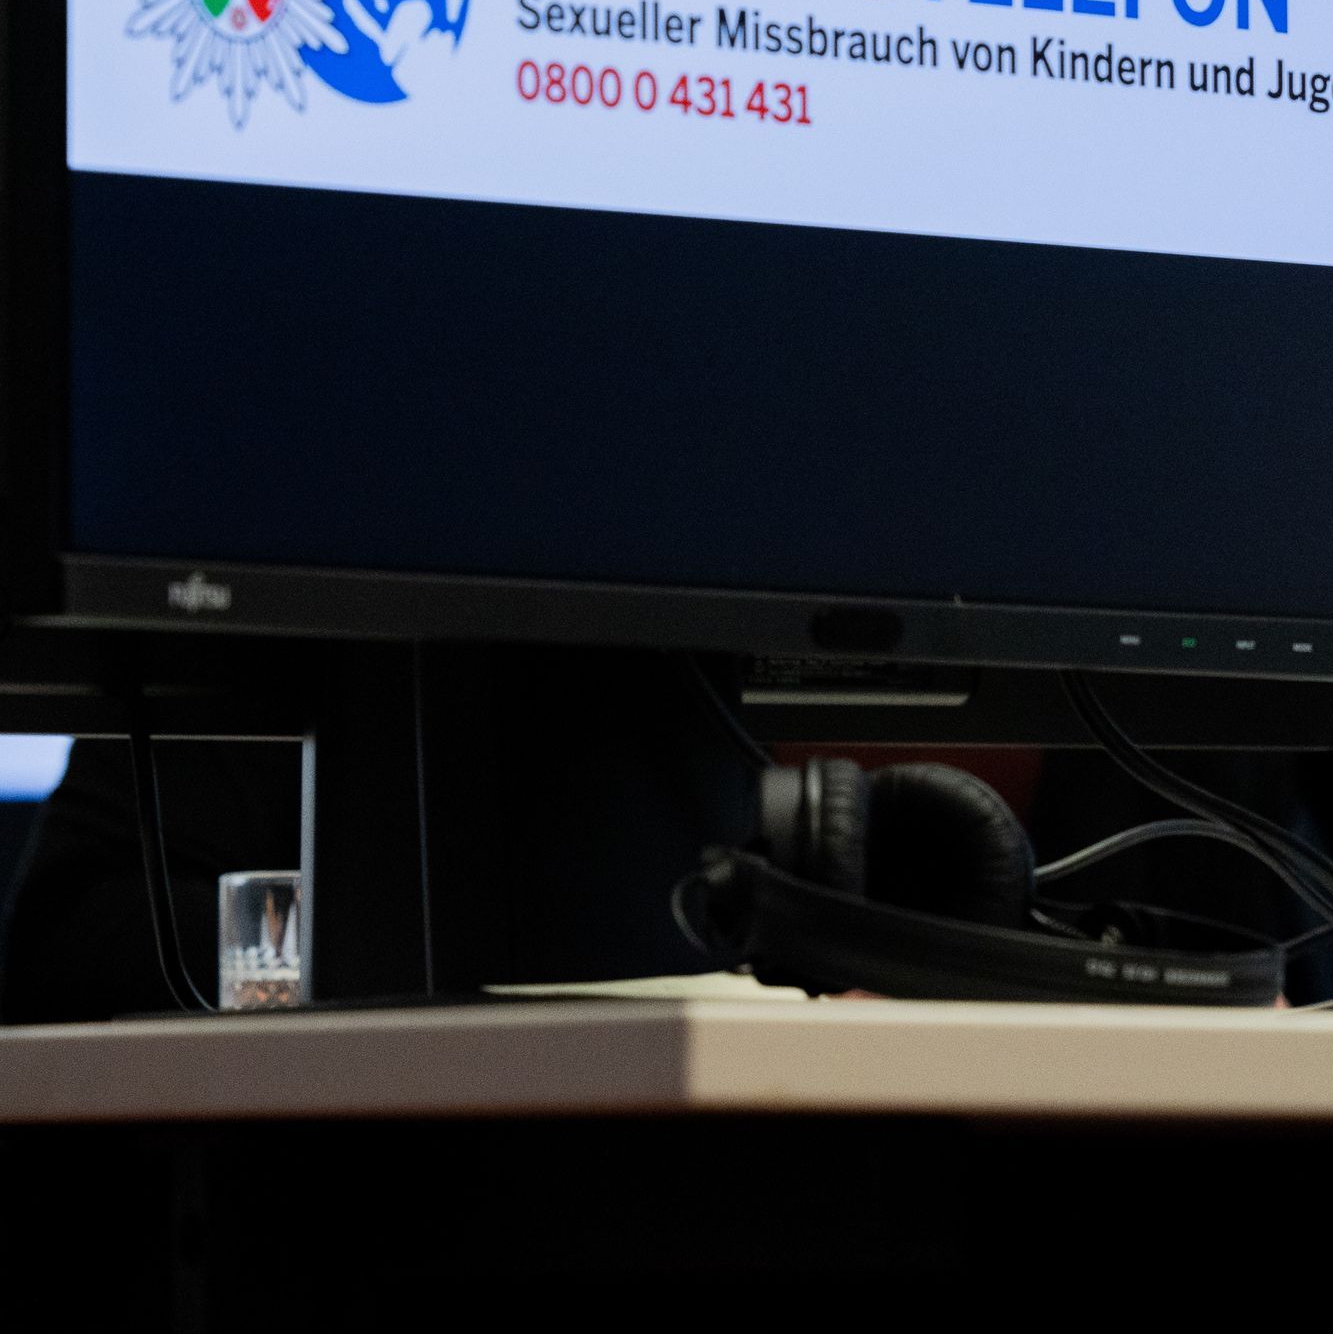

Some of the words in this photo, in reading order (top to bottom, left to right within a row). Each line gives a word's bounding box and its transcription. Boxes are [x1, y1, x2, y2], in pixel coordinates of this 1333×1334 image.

[717, 7, 939, 68] Missbrauch
[952, 38, 1016, 76] von
[1030, 34, 1176, 91] Kindern
[1188, 55, 1255, 98] und
[517, 60, 621, 108] 0800
[634, 69, 657, 112] 0
[669, 72, 734, 119] 431
[747, 79, 811, 125] 431
